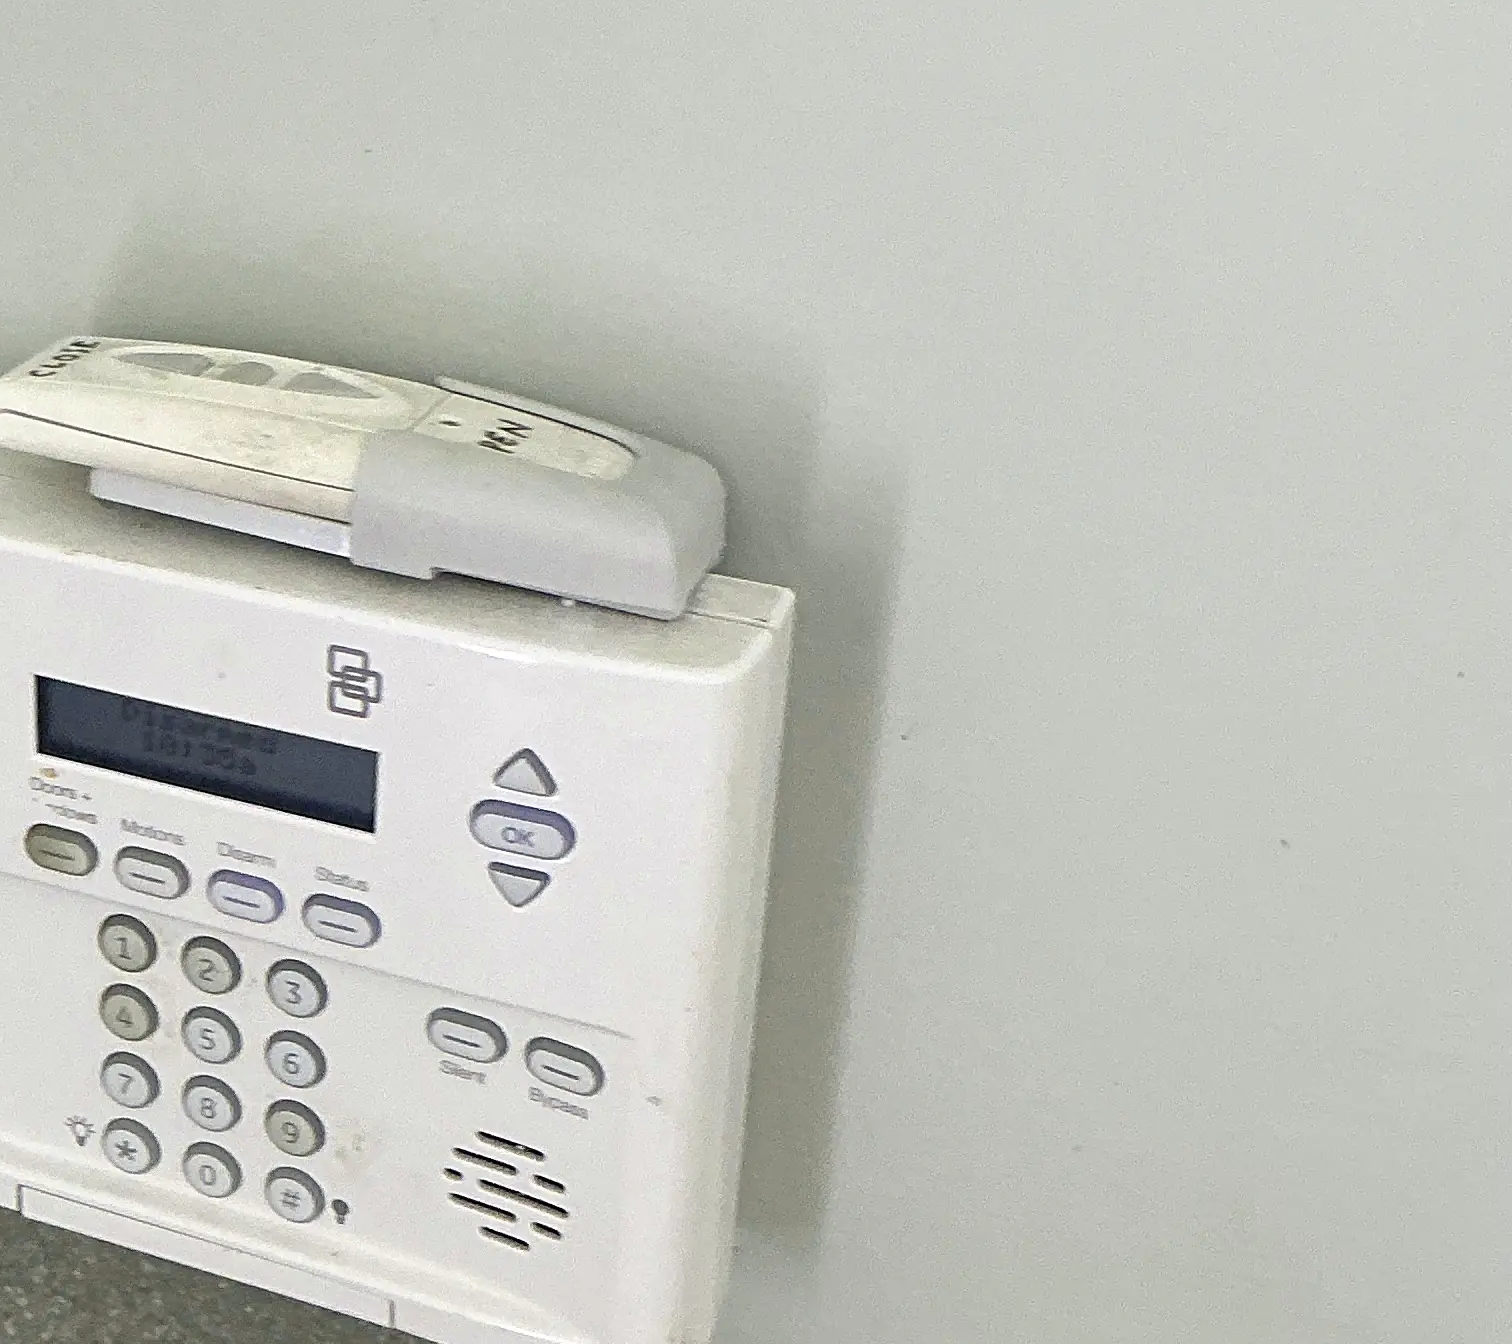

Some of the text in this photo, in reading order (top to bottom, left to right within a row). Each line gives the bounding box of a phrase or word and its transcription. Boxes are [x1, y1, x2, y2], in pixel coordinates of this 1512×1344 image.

[477, 418, 533, 454] PEN
[500, 826, 535, 847] OK
[115, 937, 132, 960] 1
[198, 958, 215, 982] 2
[285, 980, 302, 1004] 3
[117, 1006, 133, 1028] 4
[201, 1027, 216, 1050] 5
[284, 1052, 299, 1075] 6
[117, 1072, 133, 1094] 7
[200, 1098, 217, 1119] 8
[281, 1121, 299, 1144] 9
[199, 1164, 216, 1186] 0
